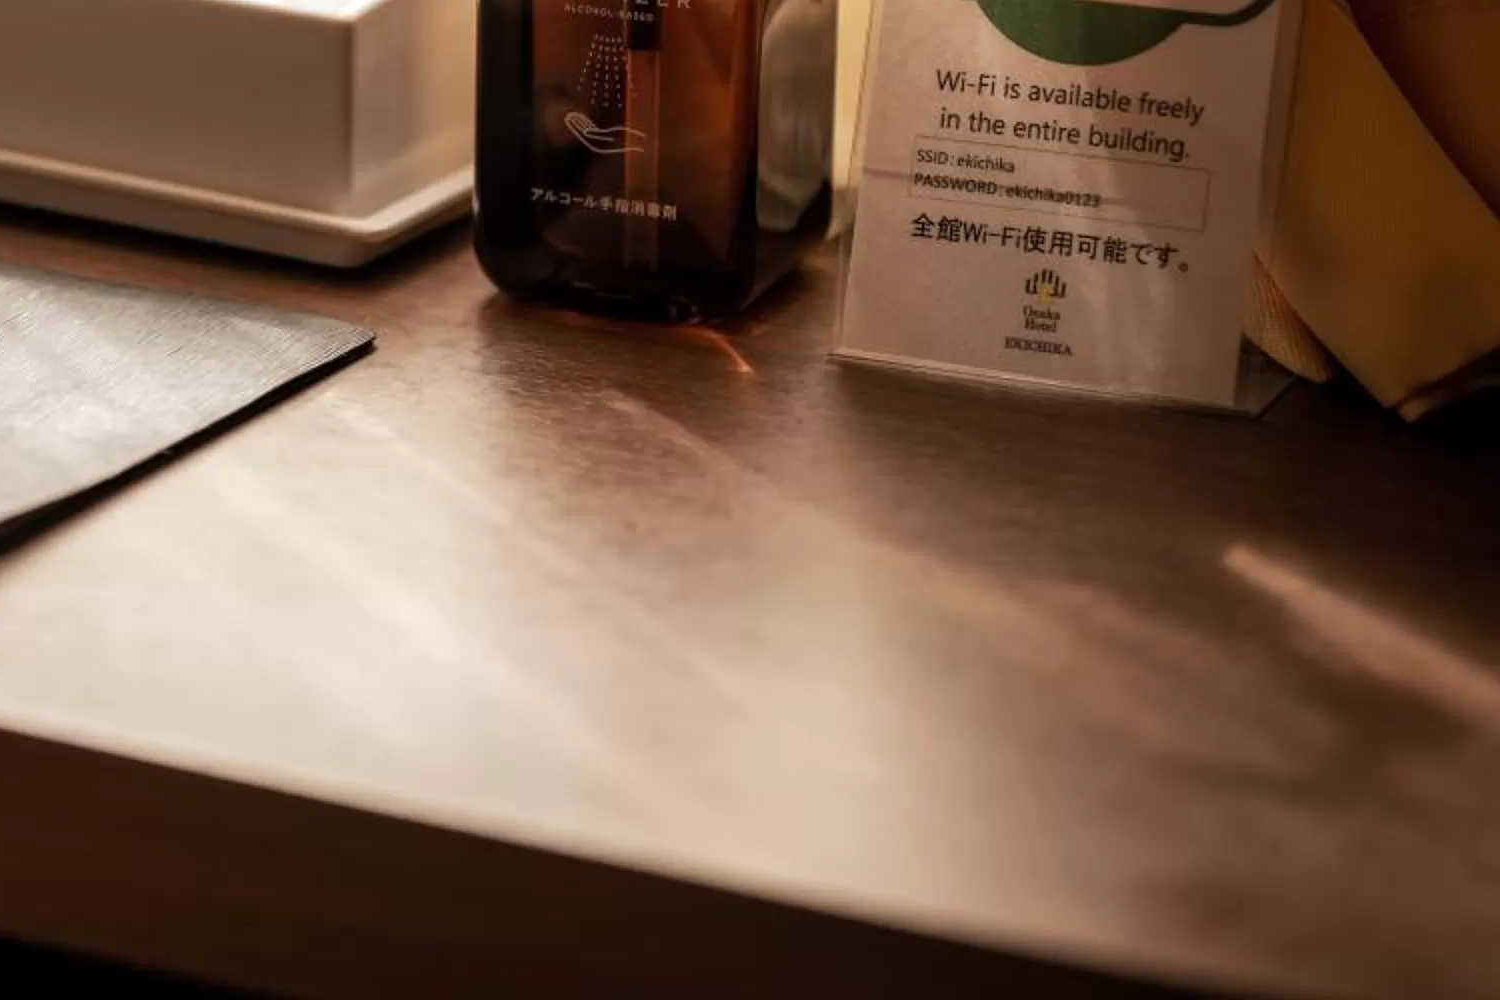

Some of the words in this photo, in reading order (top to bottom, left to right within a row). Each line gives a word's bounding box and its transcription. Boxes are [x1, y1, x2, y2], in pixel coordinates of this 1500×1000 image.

[936, 69, 997, 97] Wi-Fi
[1003, 76, 1021, 99] is
[1027, 83, 1130, 113] available
[1139, 91, 1205, 127] freely
[939, 107, 961, 130] in
[968, 111, 1006, 135] the
[1013, 119, 1081, 145] entire
[1088, 123, 1190, 163] building.
[957, 152, 1016, 174] ekichika
